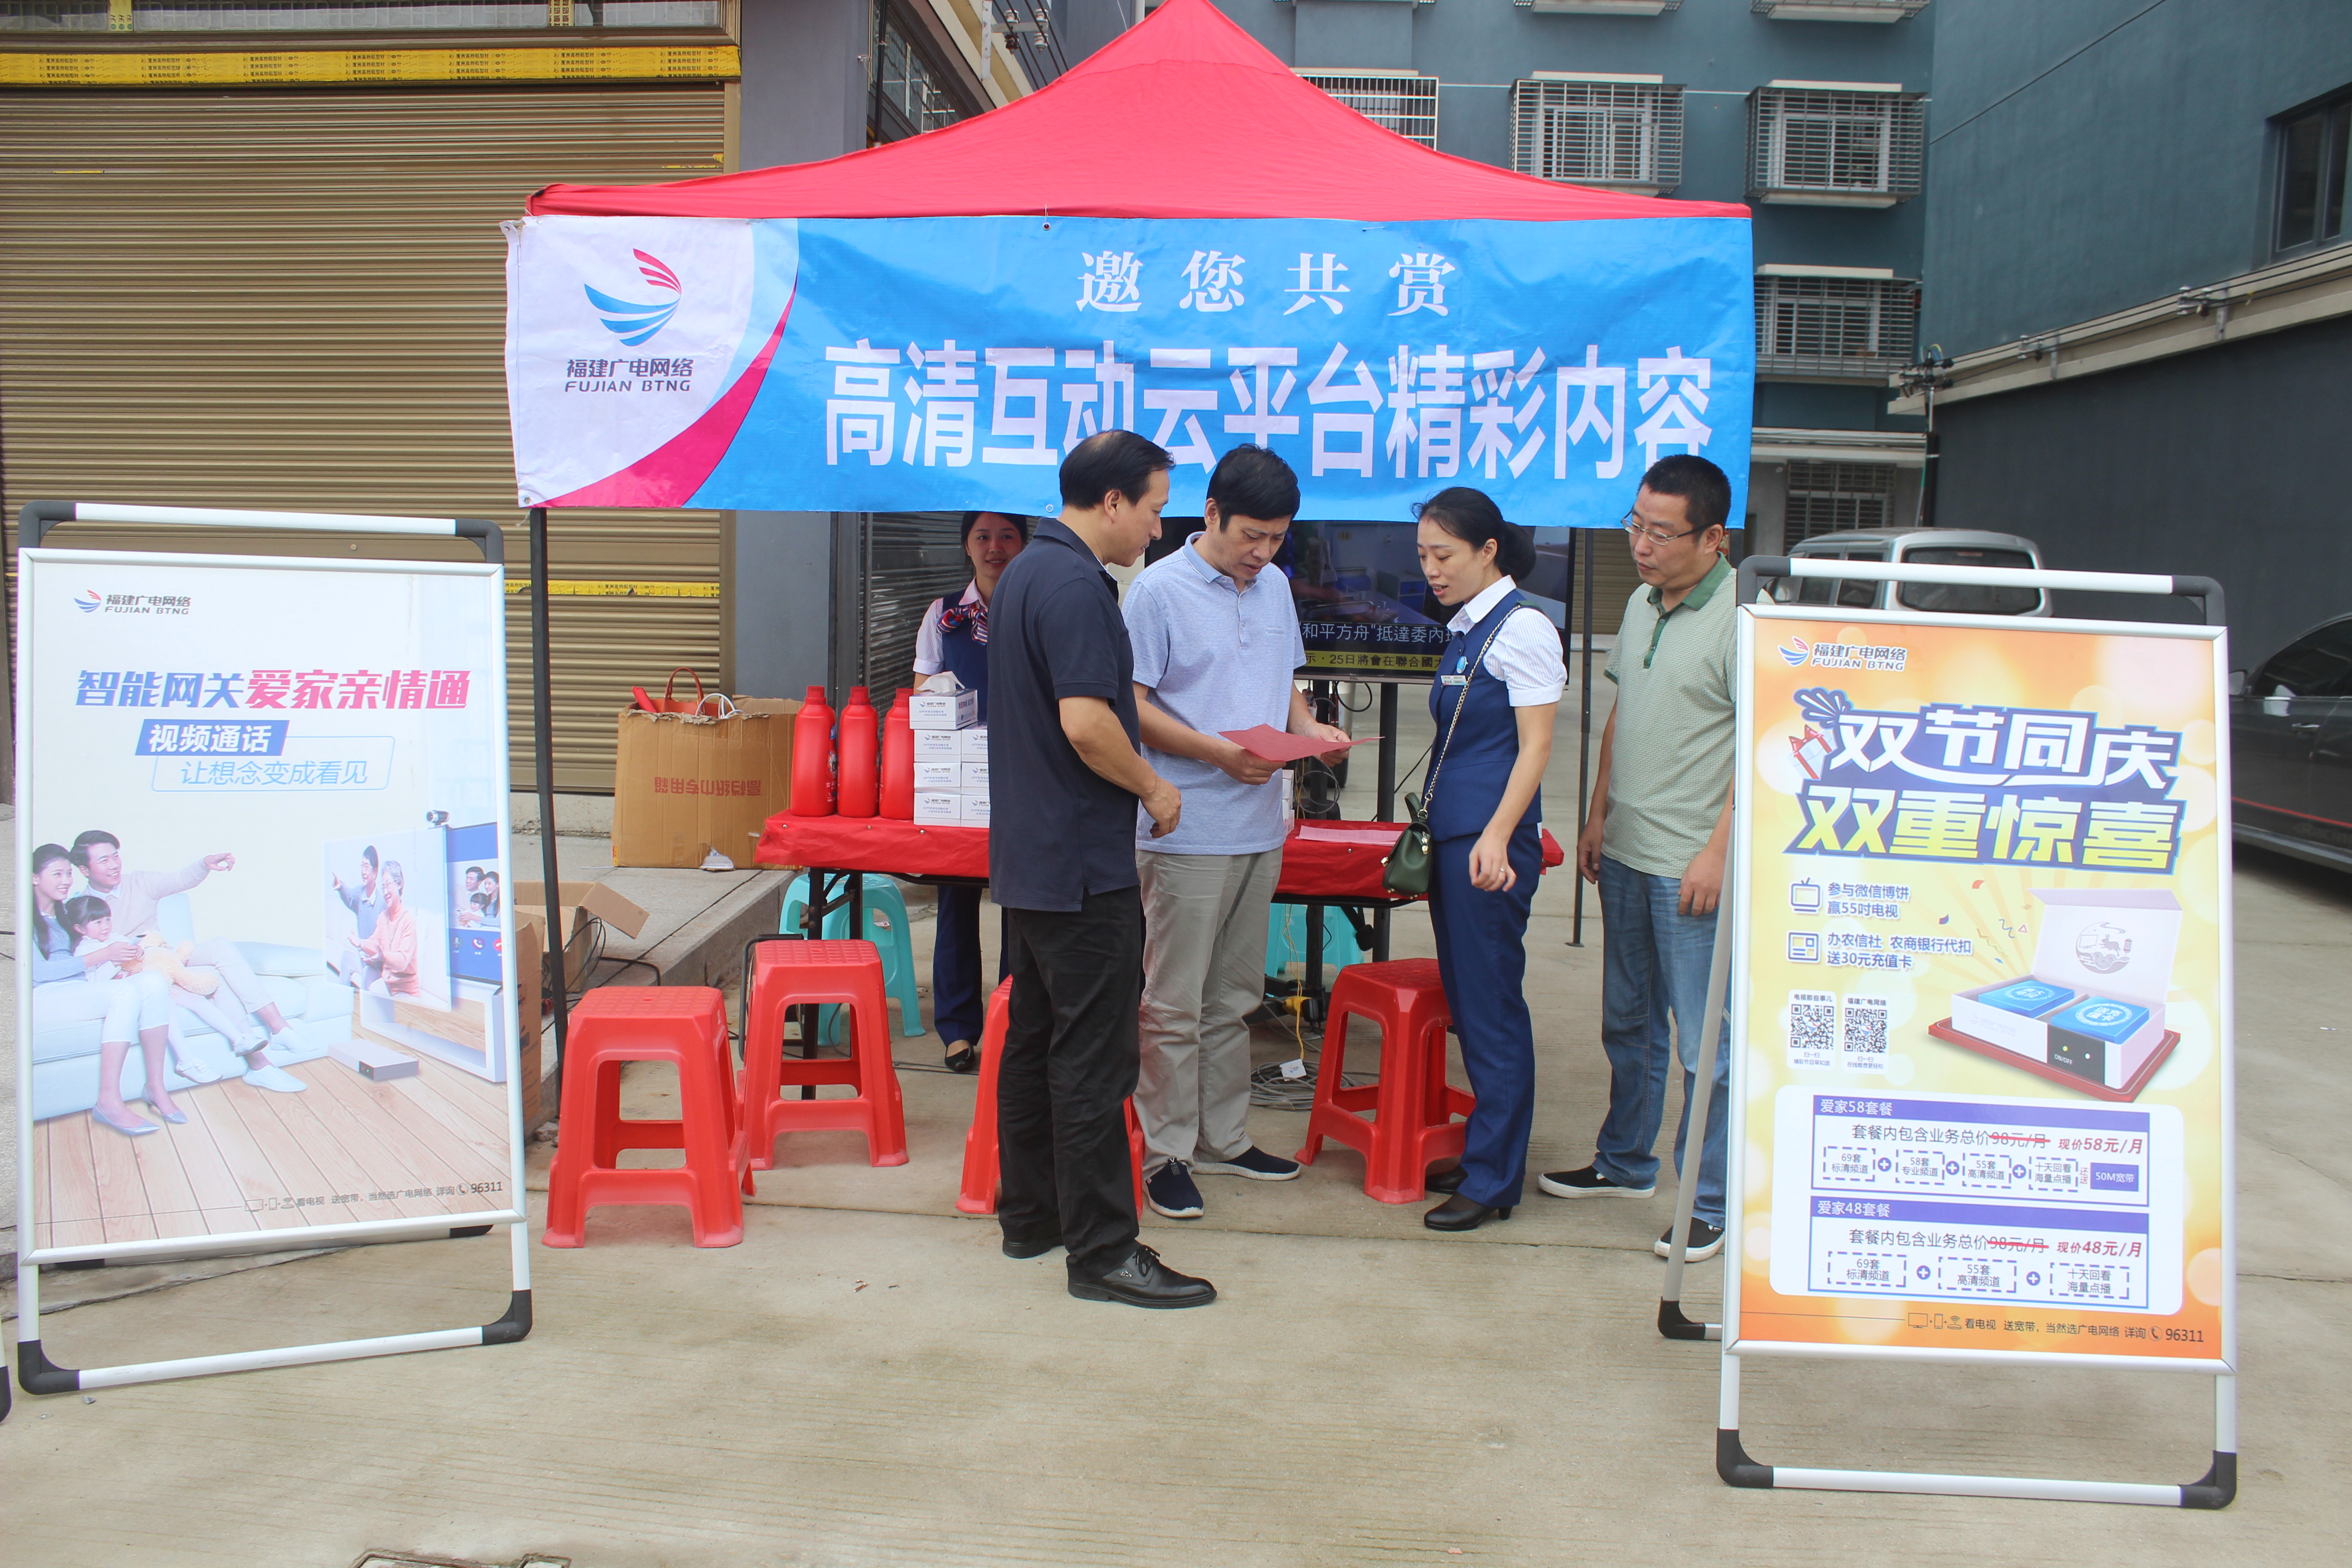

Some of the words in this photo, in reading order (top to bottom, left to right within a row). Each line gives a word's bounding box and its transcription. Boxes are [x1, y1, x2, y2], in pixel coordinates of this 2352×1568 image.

[1076, 250, 1455, 316] 邀您共赏
[567, 358, 694, 377] 福建广电网络
[565, 381, 632, 392] FUJIAN
[642, 380, 691, 392] BTNG
[826, 338, 1712, 480] 高清互动云平台精彩内容
[106, 594, 191, 607] 福建广电网络
[1814, 644, 1906, 661] 福建广电网络
[1812, 658, 1861, 668] FUJIAN
[1867, 661, 1904, 670] BTNG
[75, 670, 472, 710] 智能网关爱家亲情通
[148, 724, 272, 753] 视频通话
[1830, 709, 2174, 789] 双节同庆
[181, 760, 368, 785] 让想念变成看见
[654, 777, 761, 796] 高档纸巾专用箱
[1797, 785, 2178, 868] 双重惊喜
[1828, 882, 1909, 900] 参与微信博饼
[1827, 901, 1898, 918] 赢55吋电视
[1827, 933, 1882, 949] 办农信社
[1890, 936, 1971, 954] 农商银行代扣
[1827, 951, 1912, 968] 送30元充值卡
[1847, 998, 1886, 1006] 福建广电网络
[2054, 1054, 2073, 1065] ON/OFF
[1820, 1099, 1893, 1116] 爱家58套餐
[1852, 1124, 2046, 1148] 套餐内包含业务总价98元/月
[2058, 1138, 2143, 1154] 现价58元/月
[1841, 1154, 1861, 1163] 69套
[1910, 1157, 1930, 1166] 58套
[1976, 1160, 1996, 1170] 55套
[1832, 1163, 1868, 1174] 标清频道
[1902, 1166, 1938, 1177] 专业频道
[1968, 1169, 2004, 1180] 高清频道
[2035, 1162, 2071, 1173] 十天回看
[2079, 1167, 2088, 1185] 还送
[2034, 1173, 2071, 1184] 海量点播
[2095, 1172, 2134, 1183] 50M宽带
[297, 1196, 325, 1207] 看电视
[436, 1186, 454, 1196] 详询
[471, 1181, 503, 1193] 96311
[1817, 1200, 1890, 1218] 爱家48套餐
[1849, 1229, 2044, 1253] 套餐内包含业务总价98元/月
[2057, 1241, 2142, 1257] 现价48元/月
[1857, 1259, 1880, 1269] 69套
[1967, 1264, 1990, 1275] 55套
[1846, 1269, 1889, 1281] 标清频道
[1957, 1274, 2000, 1287] 高清频道
[2068, 1269, 2111, 1281] 十天回看
[2068, 1281, 2111, 1294] 海量点播
[1965, 1318, 1996, 1330] 看电视
[2004, 1320, 2120, 1337] 送宽带，当然选广电网络
[2125, 1327, 2146, 1339] 详询
[2165, 1328, 2204, 1342] 96311
